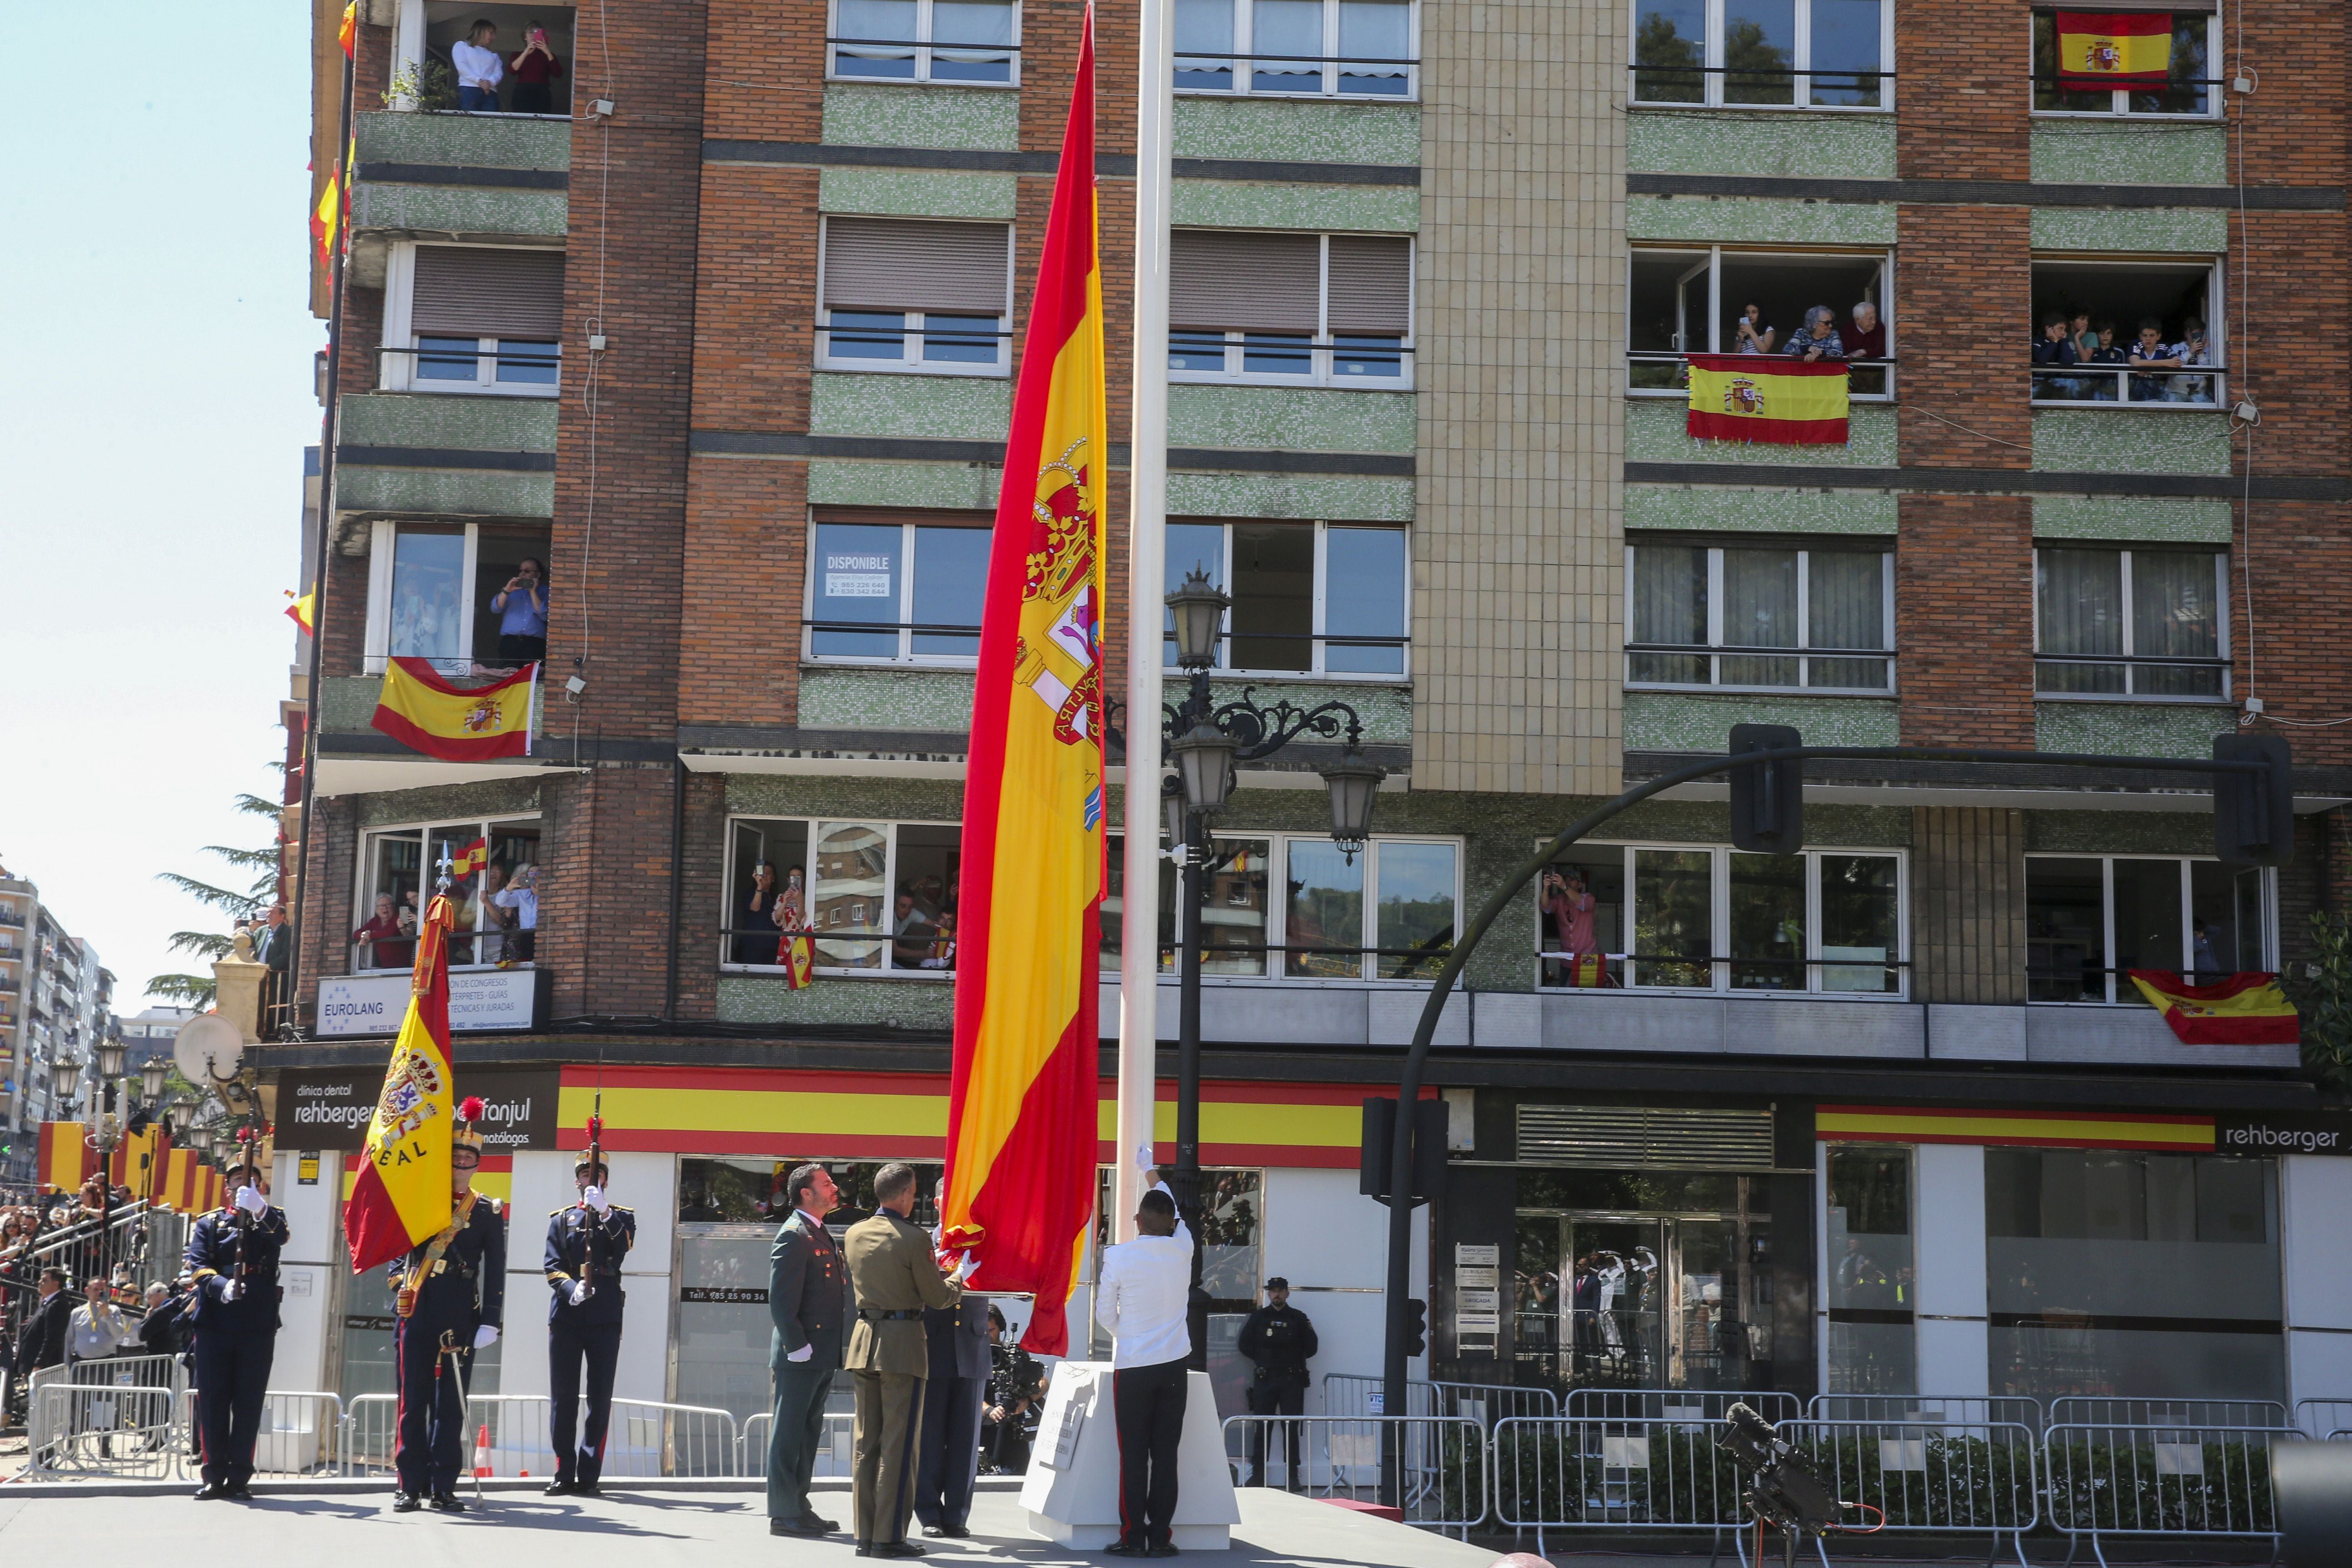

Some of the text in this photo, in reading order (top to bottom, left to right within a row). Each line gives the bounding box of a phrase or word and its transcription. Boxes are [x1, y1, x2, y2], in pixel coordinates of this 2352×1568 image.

[828, 556, 889, 570] DISPONIBLE
[470, 978, 508, 987] CONGRESOS
[489, 990, 508, 999] GUÍAS
[325, 1002, 383, 1016] EUROLANG
[451, 1004, 479, 1013] TÉCNICAS
[486, 1002, 514, 1012] JURADAS
[297, 1084, 352, 1096] clínica dental
[295, 1100, 375, 1129] rehberger
[481, 1098, 531, 1128] fanjul
[2226, 1124, 2339, 1152] rehberger
[367, 1142, 427, 1166] REAL
[710, 1292, 725, 1300] 985
